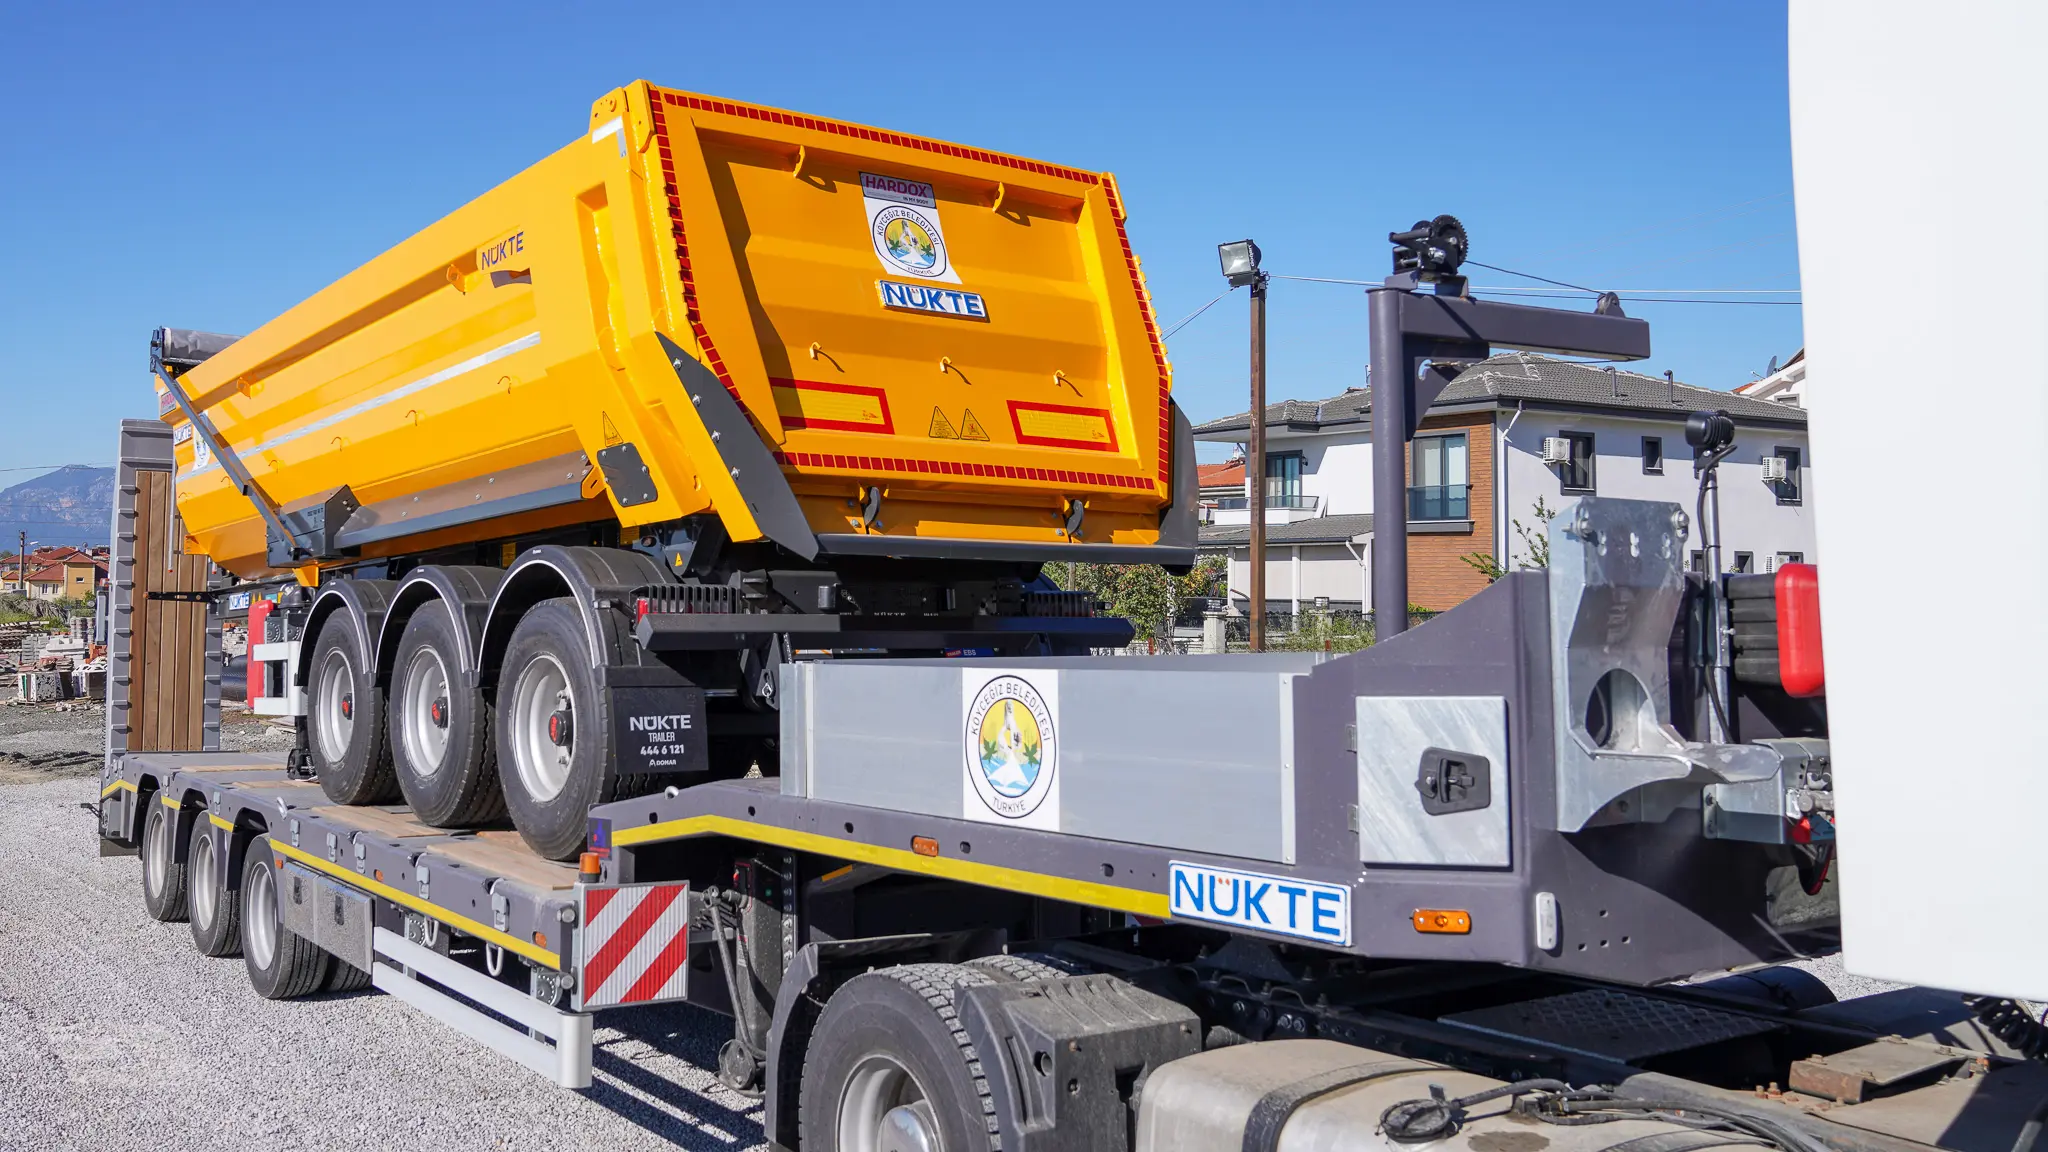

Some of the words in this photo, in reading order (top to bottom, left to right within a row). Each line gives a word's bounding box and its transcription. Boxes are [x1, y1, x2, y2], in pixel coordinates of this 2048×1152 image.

[865, 175, 928, 198] HARDOX
[481, 231, 524, 270] NÜKTE
[884, 283, 983, 315] NÜKTE
[629, 714, 692, 731] NÜKTE
[648, 732, 675, 742] TRAILER
[640, 746, 659, 755] 444
[661, 745, 668, 755] 6
[669, 744, 684, 754] 121
[1175, 869, 1341, 937] NÜKTE
